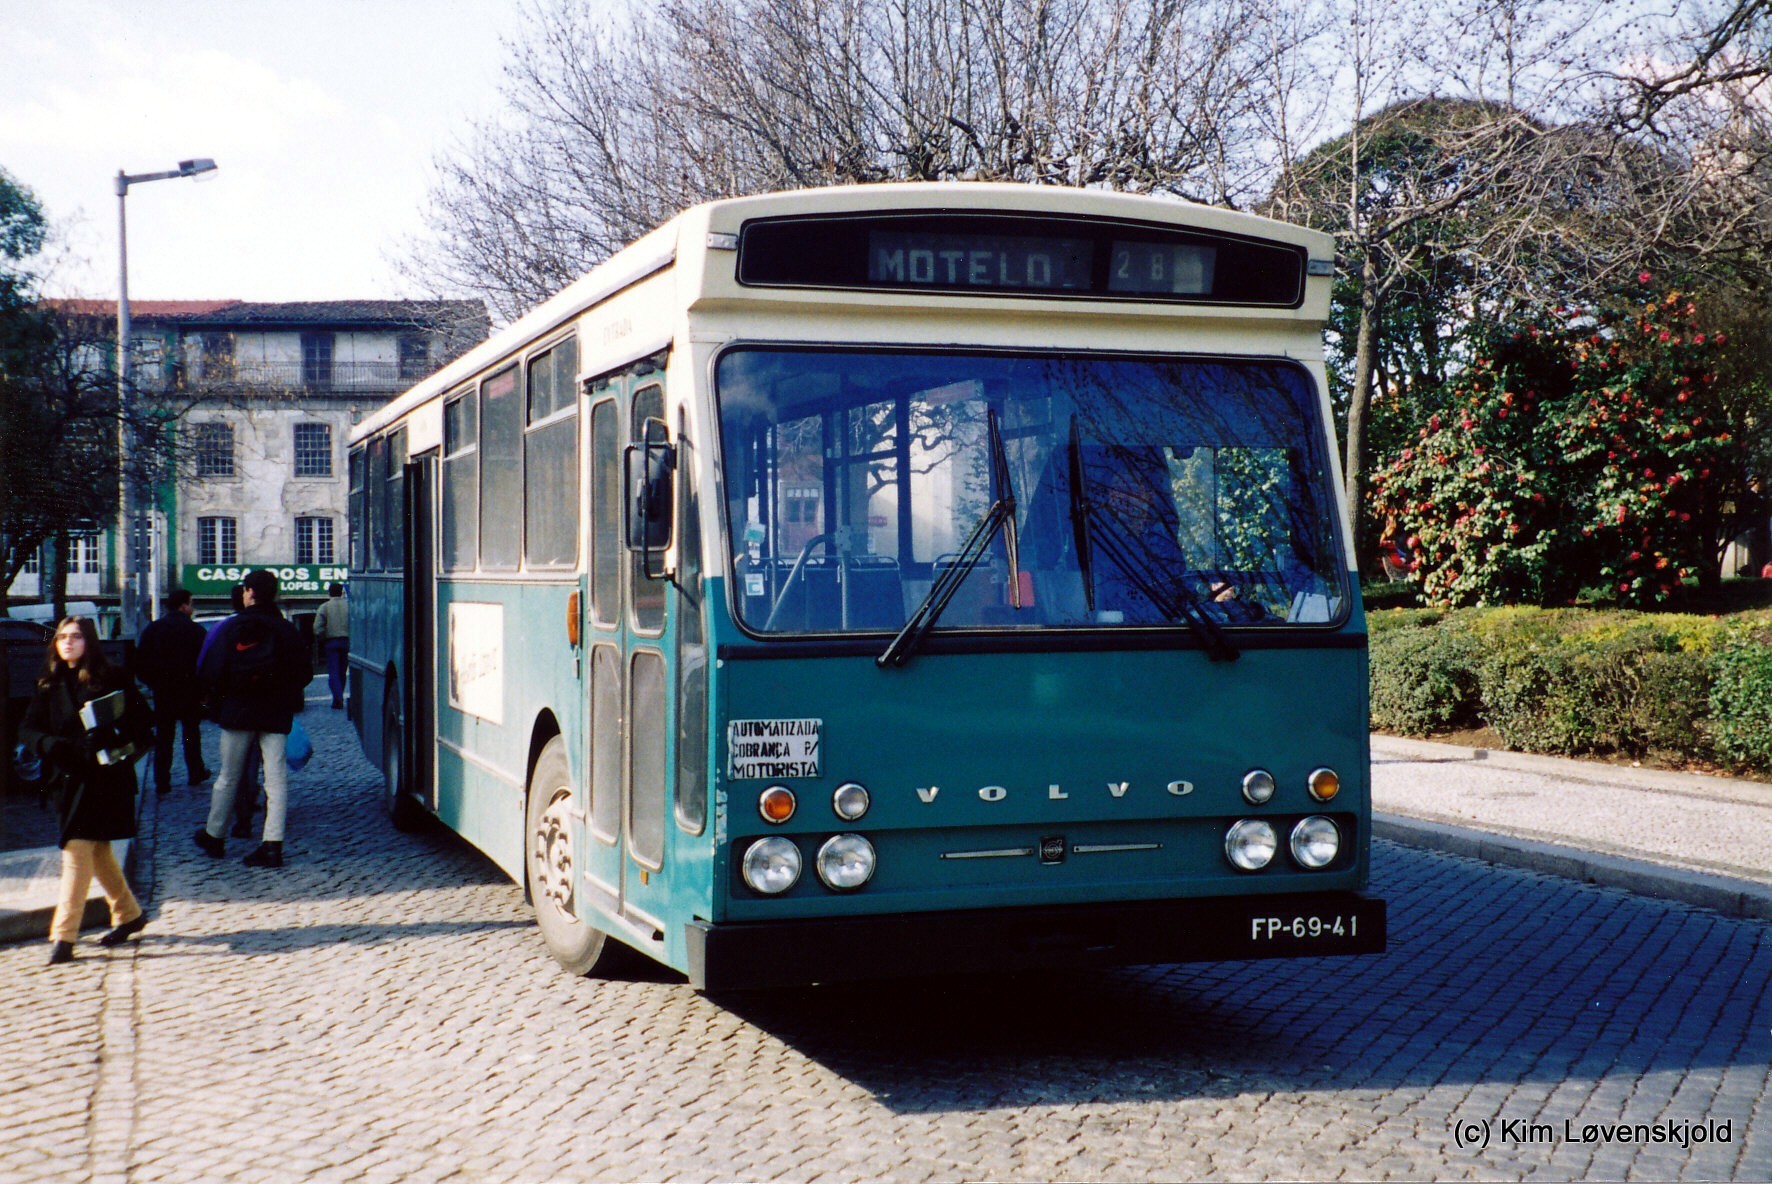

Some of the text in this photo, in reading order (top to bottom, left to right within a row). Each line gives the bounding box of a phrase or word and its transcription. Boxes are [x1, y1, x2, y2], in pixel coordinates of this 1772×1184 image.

[281, 581, 318, 591] LOPES
[733, 741, 791, 759] COBRANÇA
[732, 761, 819, 778] MOTORISTA
[916, 780, 1194, 802] VOLVO
[1252, 915, 1357, 940] FP-69-41
